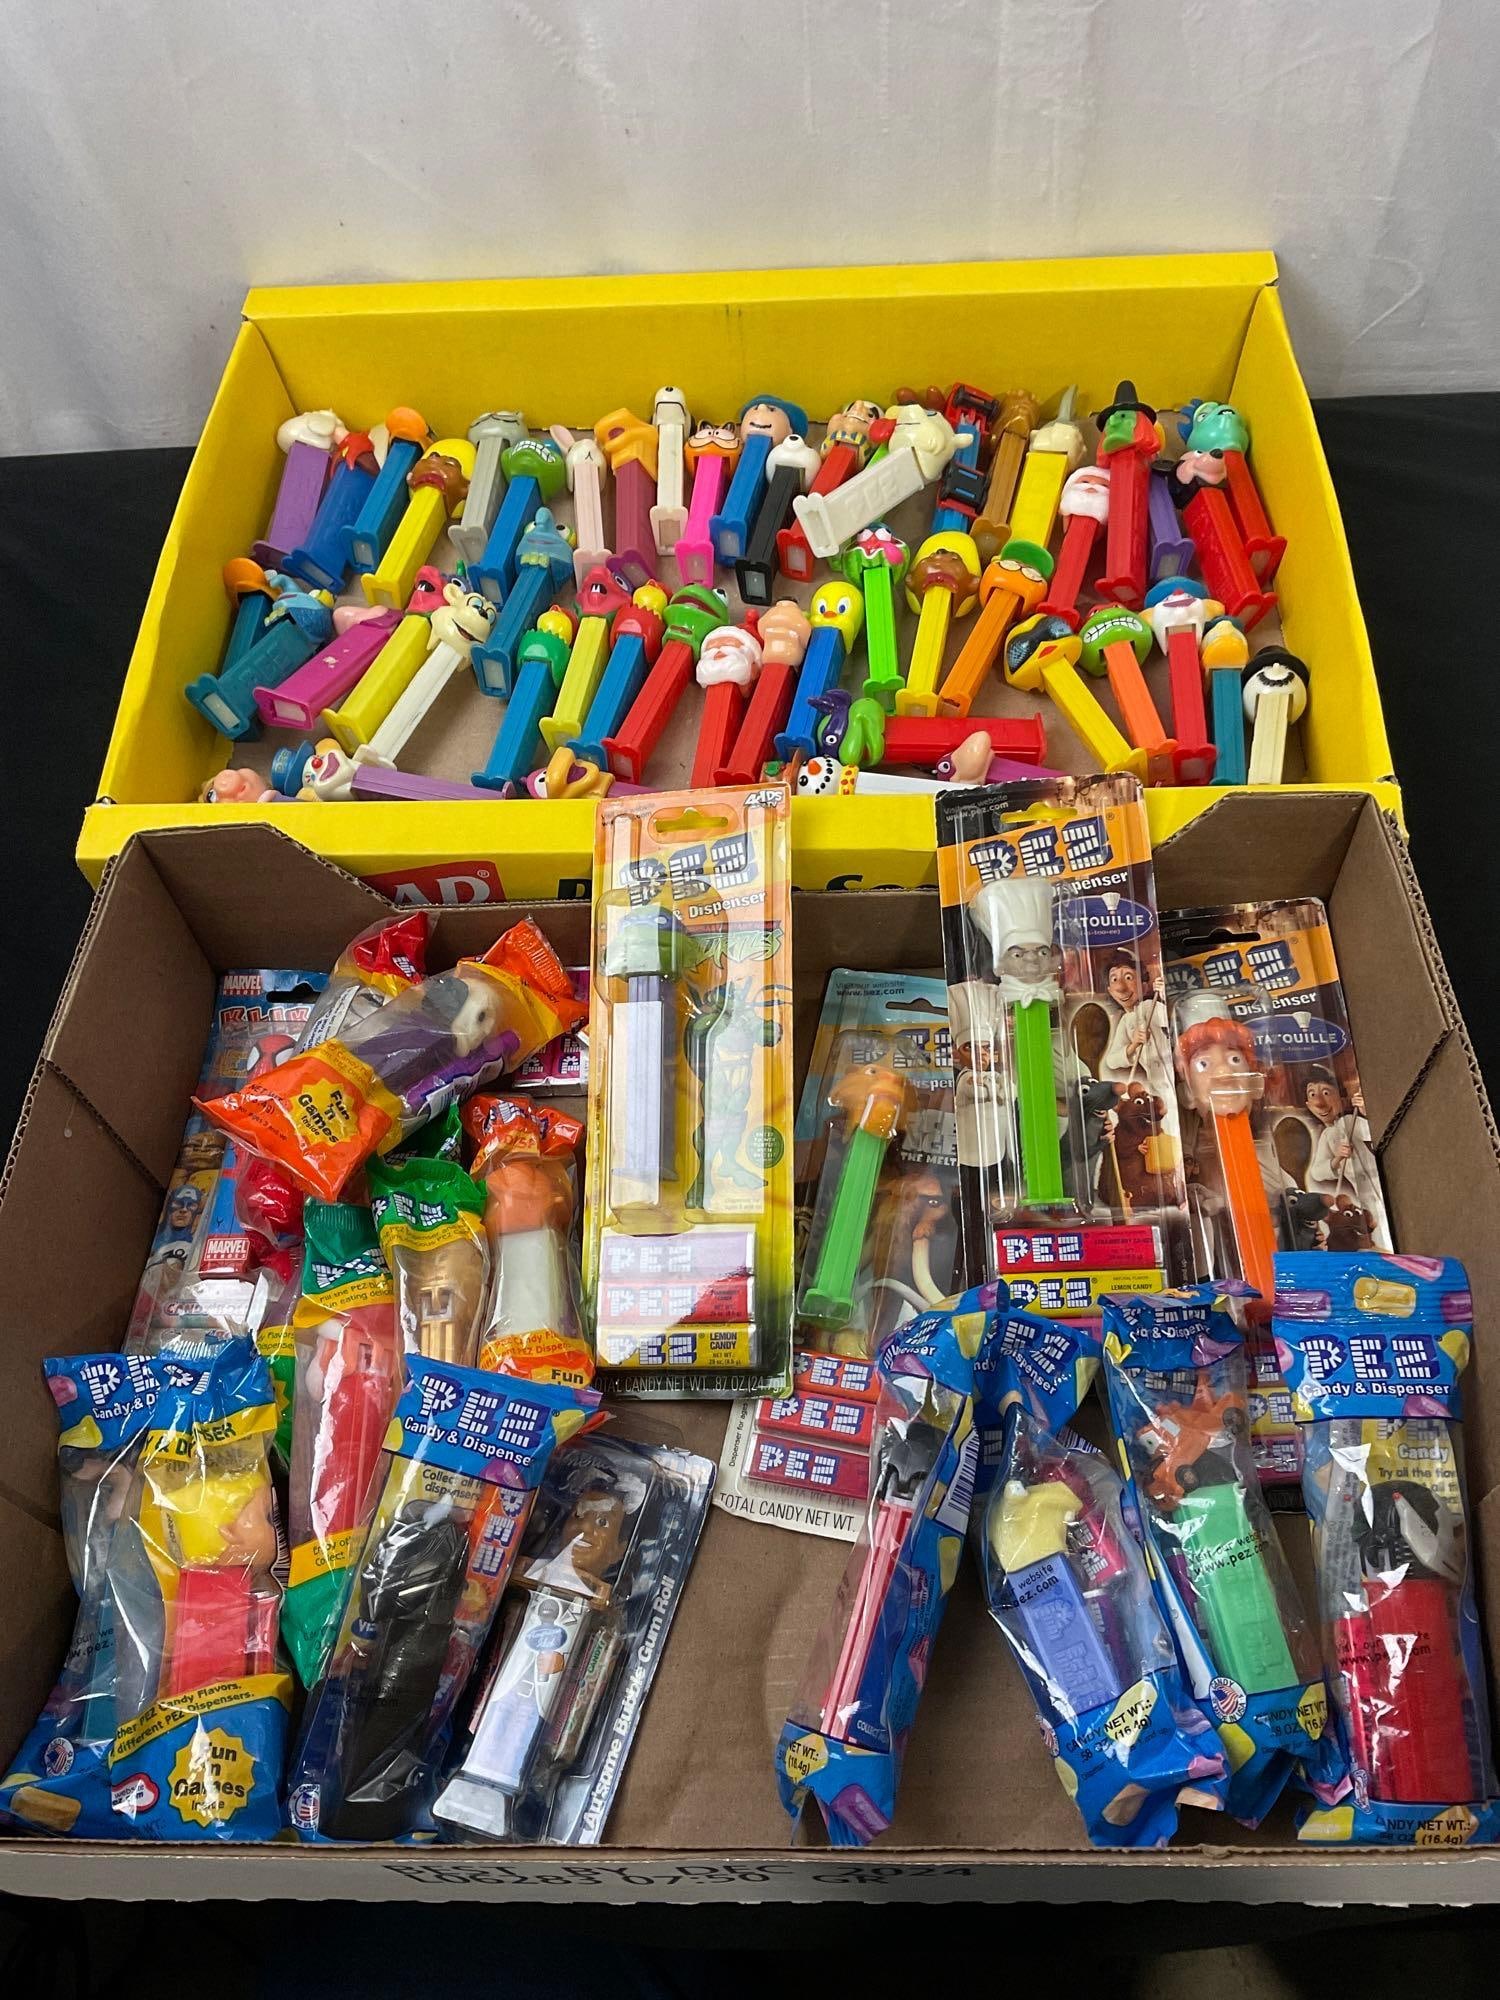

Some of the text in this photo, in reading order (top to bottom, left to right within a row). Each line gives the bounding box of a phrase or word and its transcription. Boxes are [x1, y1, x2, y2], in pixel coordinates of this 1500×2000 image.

[968, 817, 1113, 883] PEZ
[620, 834, 757, 909] PEZ
[689, 891, 767, 918] Dispenser
[1054, 914, 1144, 930] ATATOUILLE
[223, 976, 262, 990] MARVEL
[298, 1094, 339, 1143] Games
[330, 1090, 350, 1121] Fun
[301, 1116, 320, 1136] Inside
[901, 1151, 958, 1166] THE MELT
[207, 1239, 247, 1254] MARVEL
[607, 1245, 693, 1273] PEZ
[1002, 1233, 1083, 1264] PEZ
[607, 1287, 698, 1317] PEZ
[1010, 1278, 1093, 1309] PEZ
[710, 1332, 737, 1341] LEMON
[710, 1341, 736, 1350] CANDY
[1152, 1327, 1161, 1338] &
[607, 1333, 698, 1366] PEZ
[1299, 1334, 1440, 1380] PEZ
[551, 1369, 584, 1385] Fun
[625, 1375, 664, 1392] CANDY
[666, 1376, 687, 1391] NET
[1302, 1382, 1451, 1397] Candy & Dispenser
[92, 1397, 144, 1419] Candy &
[421, 1374, 549, 1448] PEZ
[770, 1397, 864, 1435] PEZ
[403, 1416, 446, 1442] Candy
[447, 1431, 458, 1444] &
[729, 1433, 741, 1467] Dispenser
[737, 1420, 745, 1432] for
[759, 1443, 839, 1485] PEZ
[1398, 1442, 1449, 1464] Candy
[1378, 1467, 1392, 1479] Try
[1396, 1467, 1408, 1477] all
[1412, 1467, 1432, 1477] the
[720, 1492, 857, 1533] TOTAL CANDY NET WT.
[472, 1488, 525, 1577] PEZ
[1194, 1541, 1270, 1577] www.pez.com
[1017, 1563, 1054, 1590] website
[115, 1683, 242, 1741] ther PEZ Candy Flavors.
[583, 1574, 675, 1832] Au'some Bubble Gum Roll
[1297, 1703, 1314, 1718] NET
[117, 1691, 255, 1752] different PEZ Dispensers.
[1104, 1711, 1127, 1731] NET
[1418, 1821, 1443, 1830] NET
[1422, 1834, 1463, 1846] (16.4g)
[382, 1864, 976, 1877] BEST BY DEC 2024
[624, 1873, 770, 1886] 07:50
[813, 1874, 889, 1884] GR
